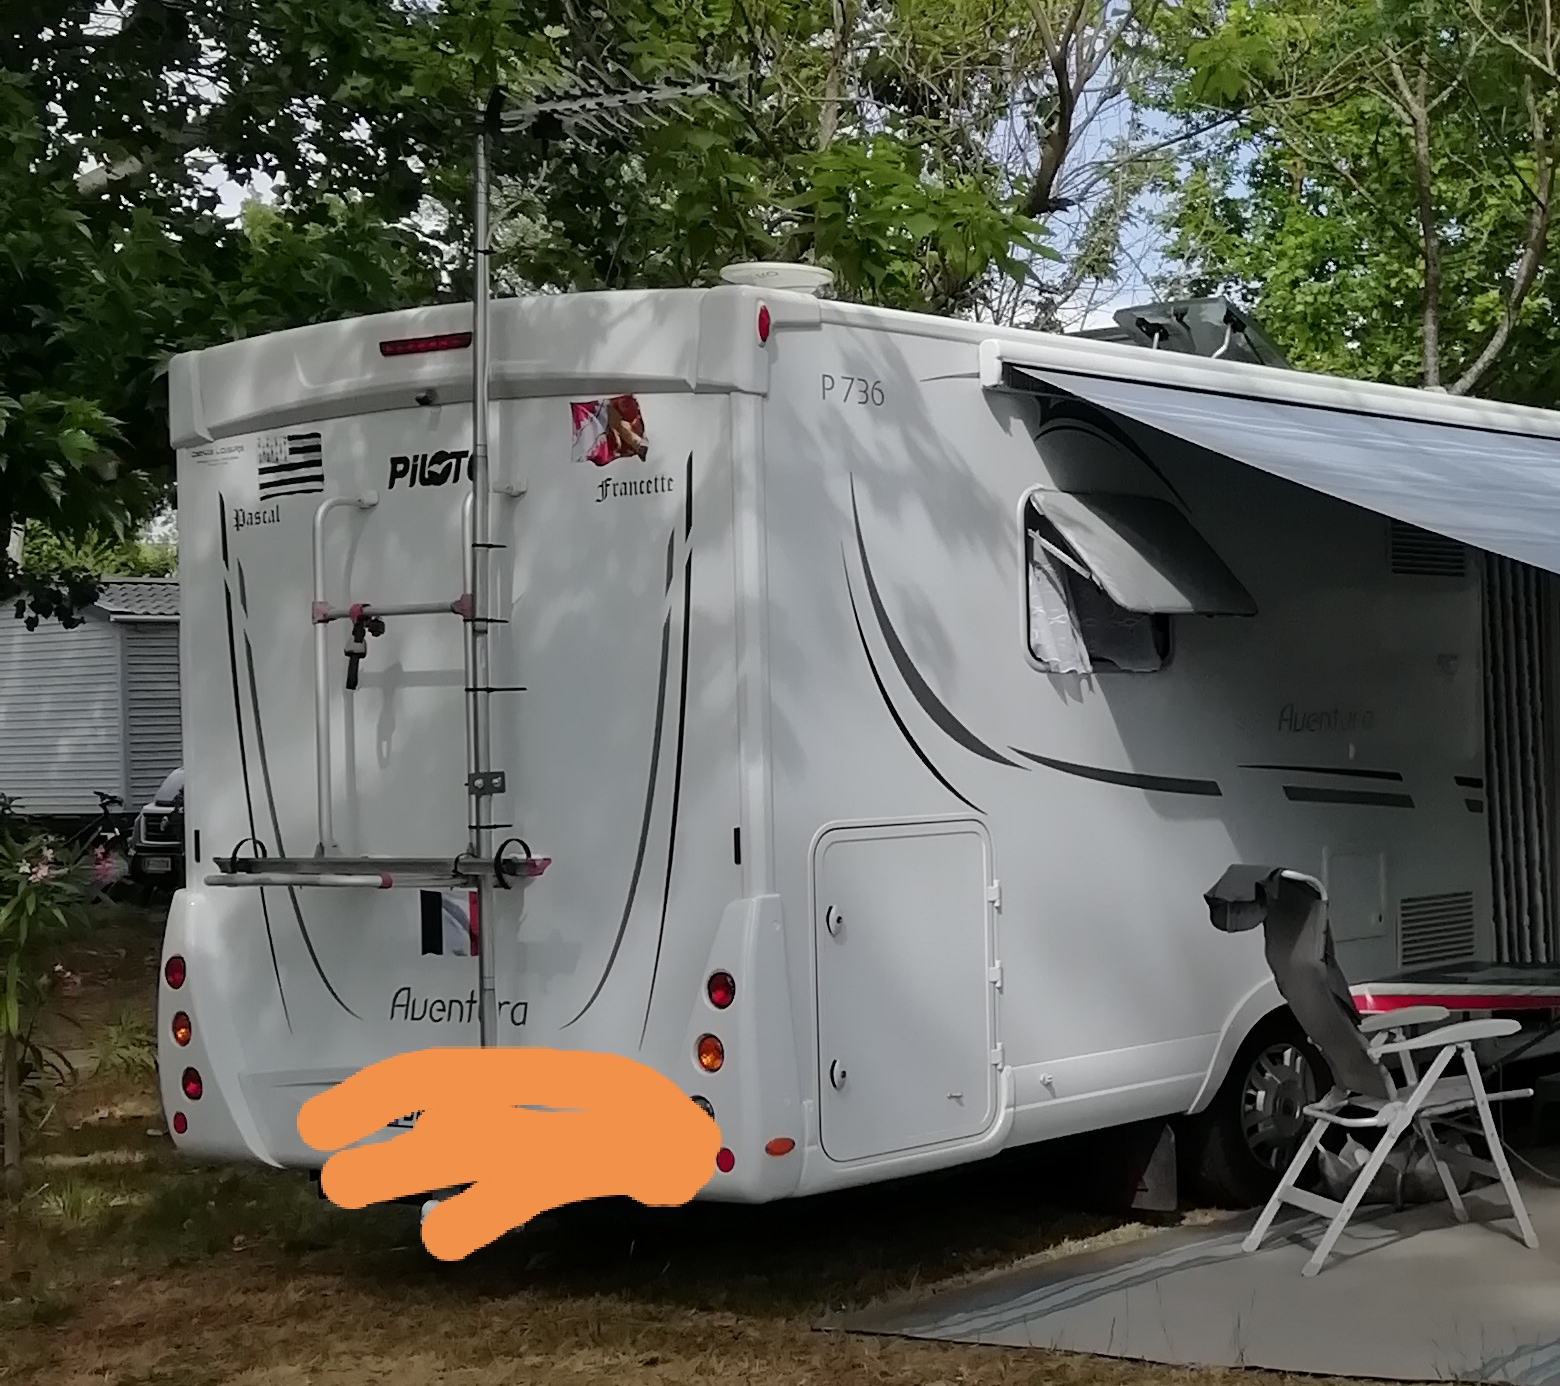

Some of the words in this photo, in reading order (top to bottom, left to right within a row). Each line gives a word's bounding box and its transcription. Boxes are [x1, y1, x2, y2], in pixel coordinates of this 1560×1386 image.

[822, 374, 835, 400] P
[841, 376, 885, 406] 736
[595, 475, 674, 502] Francette
[233, 505, 280, 531] Pascal
[390, 987, 528, 1026] Aventra
